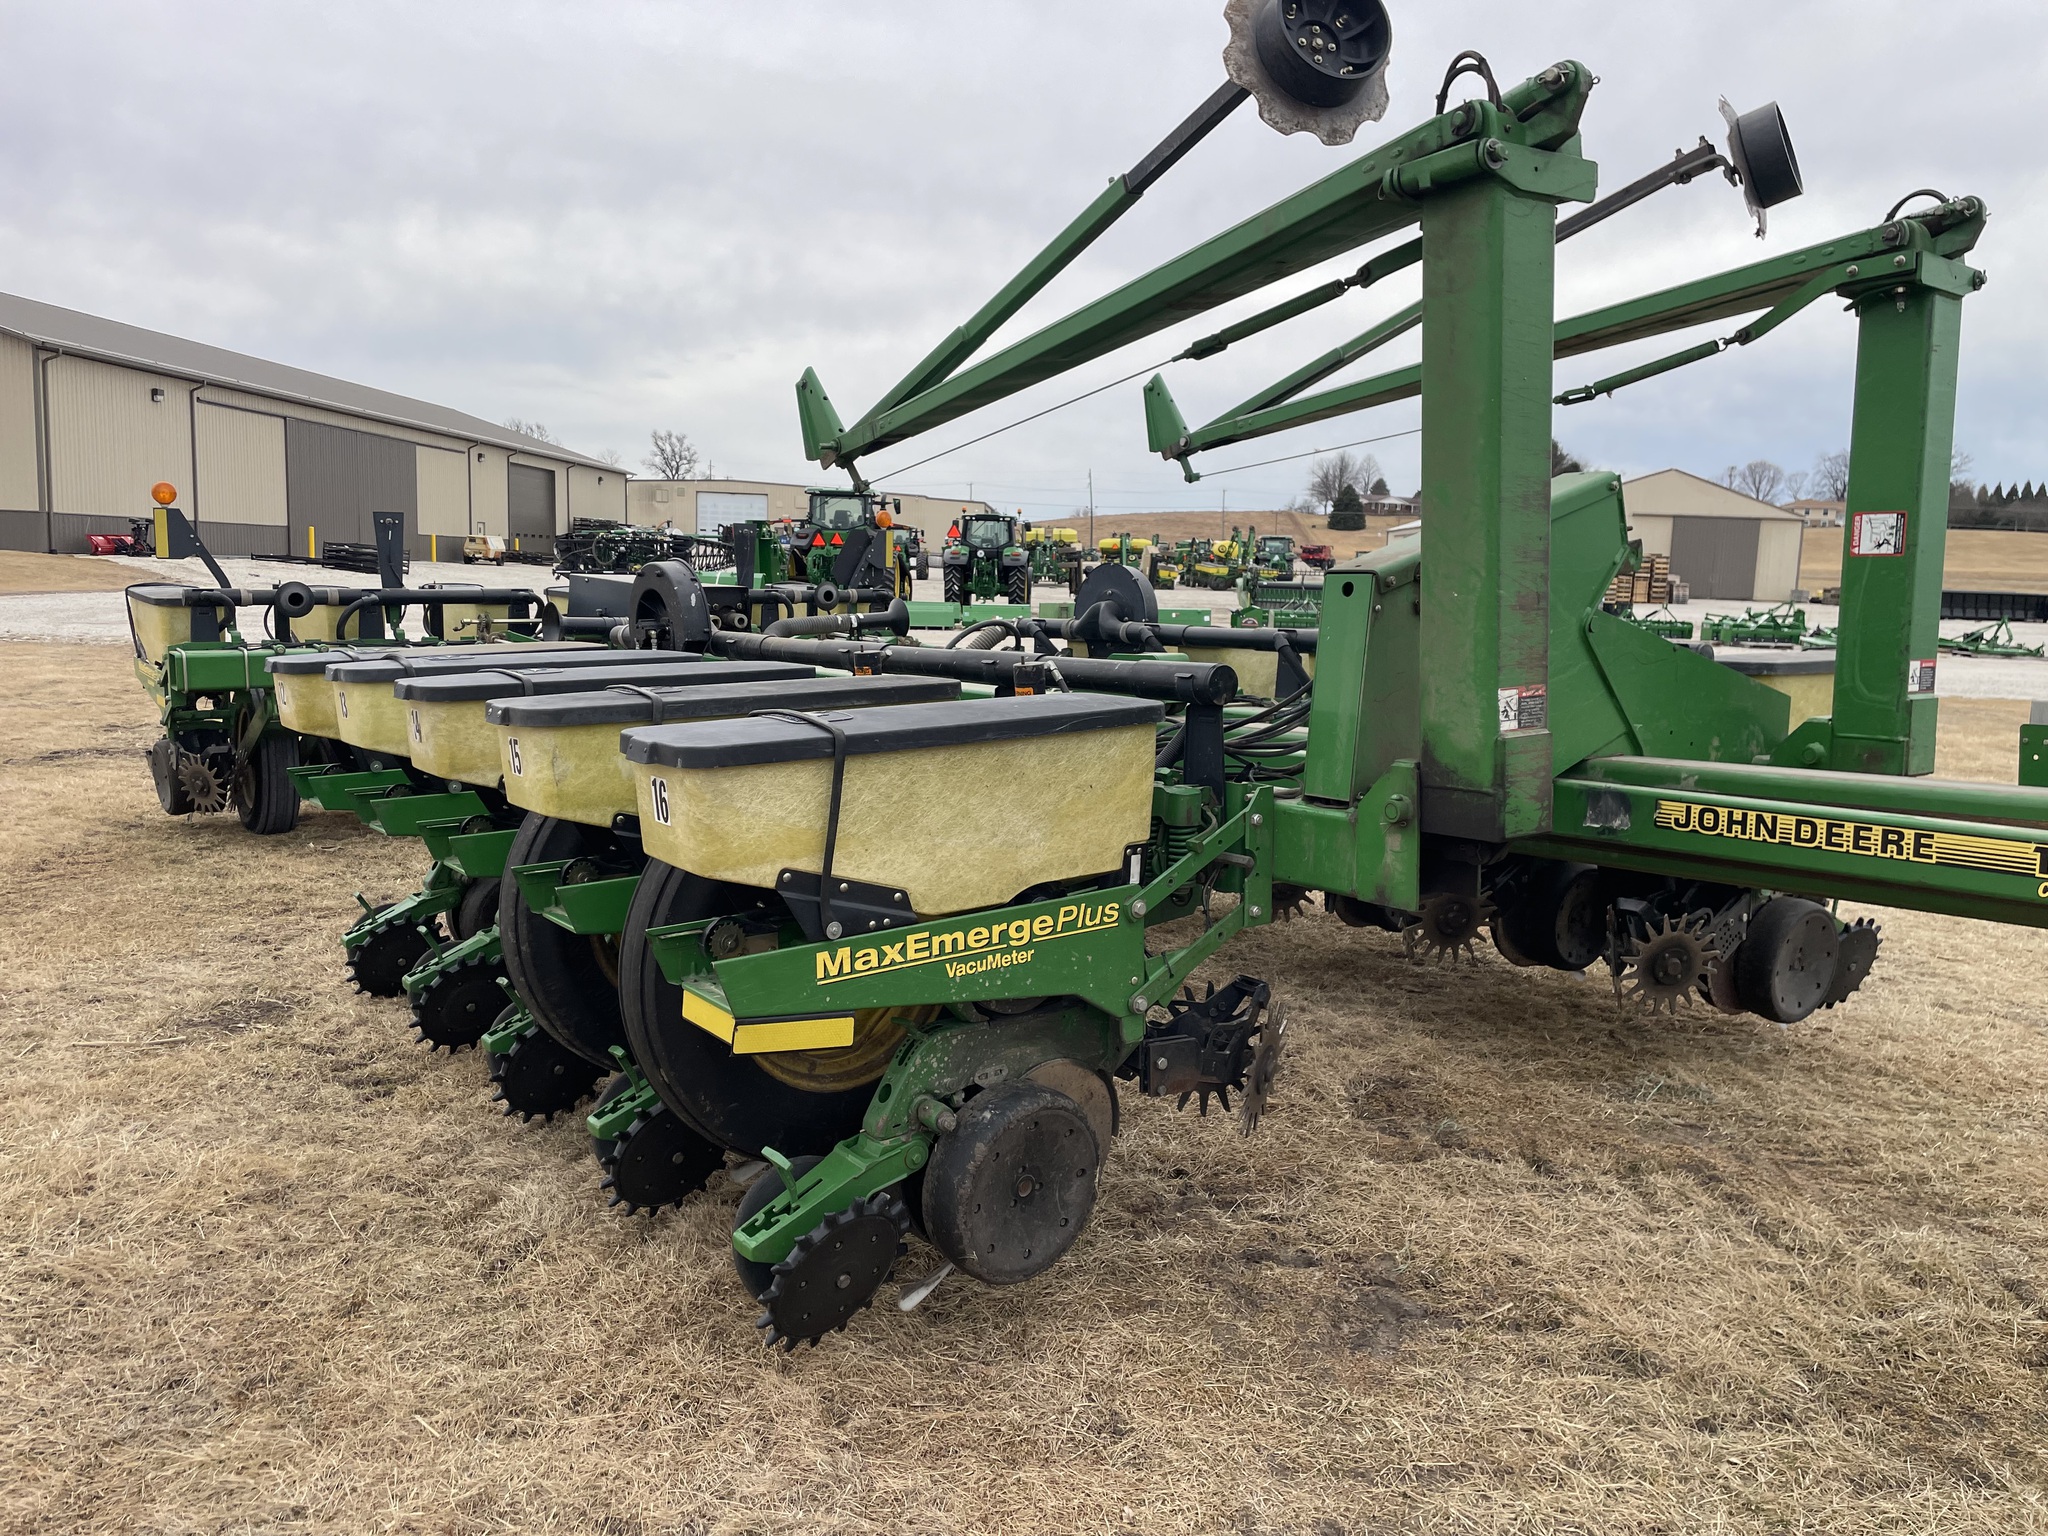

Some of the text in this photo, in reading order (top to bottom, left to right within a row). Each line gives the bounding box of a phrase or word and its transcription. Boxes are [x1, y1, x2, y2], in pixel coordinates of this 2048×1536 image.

[1853, 515, 1861, 546] DANGER
[339, 691, 348, 718] 13
[411, 709, 422, 743] 14
[509, 738, 522, 775] 15
[651, 778, 669, 823] 16
[1672, 803, 1936, 862] JOHN DEERE
[945, 948, 1035, 979] VacuMeter
